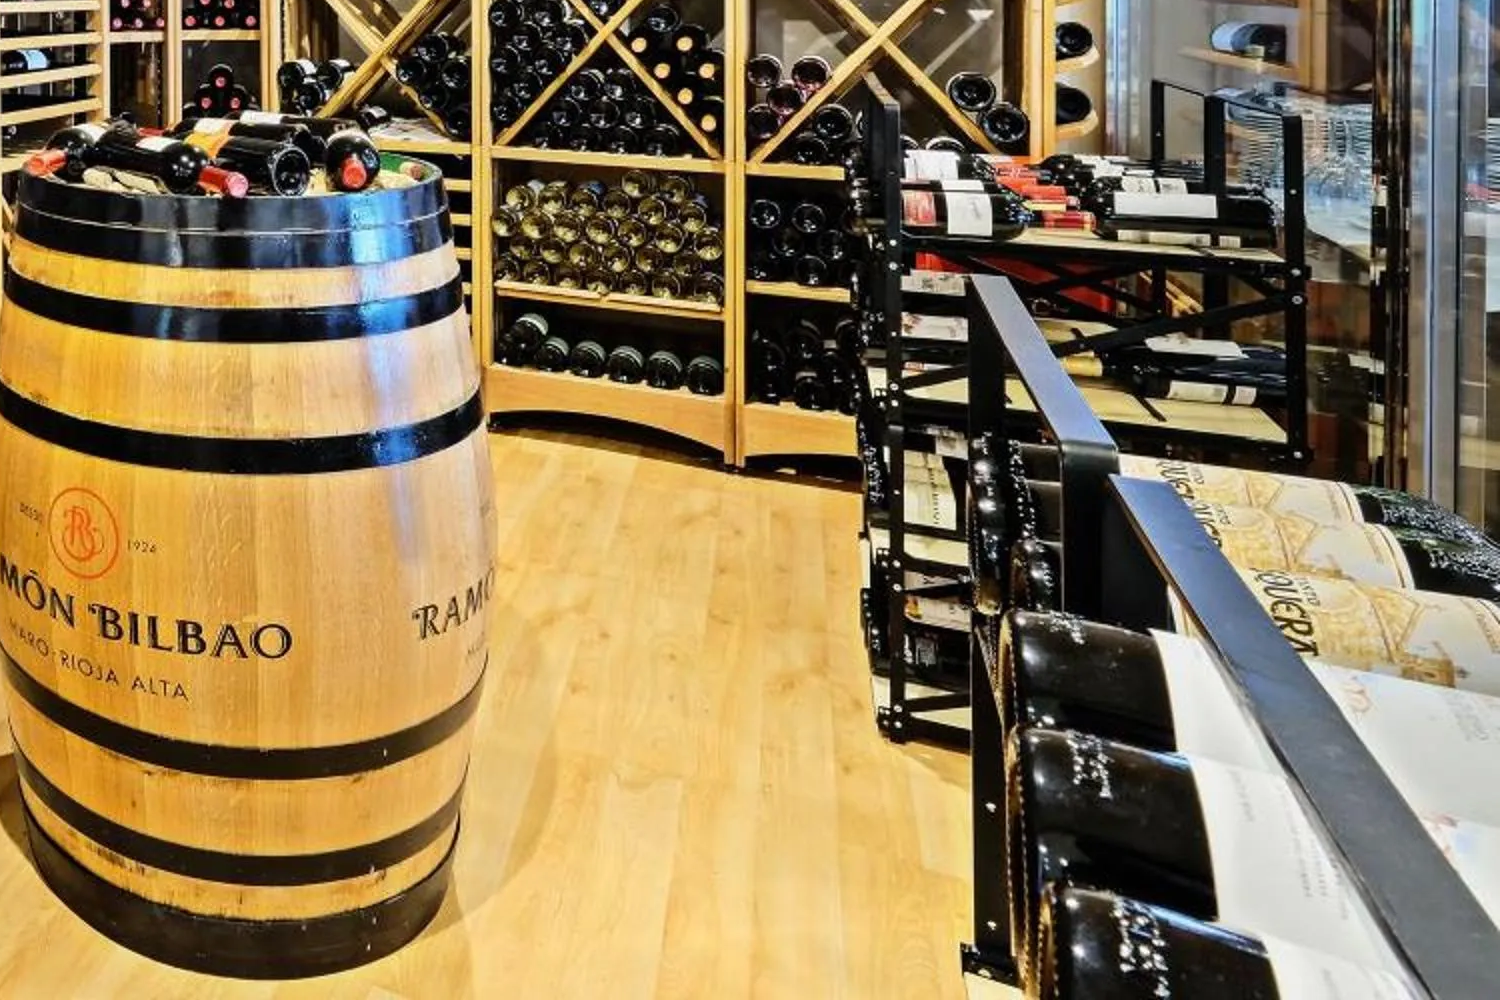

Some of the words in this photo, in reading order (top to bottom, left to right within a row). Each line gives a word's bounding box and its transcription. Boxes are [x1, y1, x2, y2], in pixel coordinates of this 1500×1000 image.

[87, 603, 293, 660] BILBAO
[59, 649, 120, 687] RIOJA
[131, 675, 190, 702] ALTA
